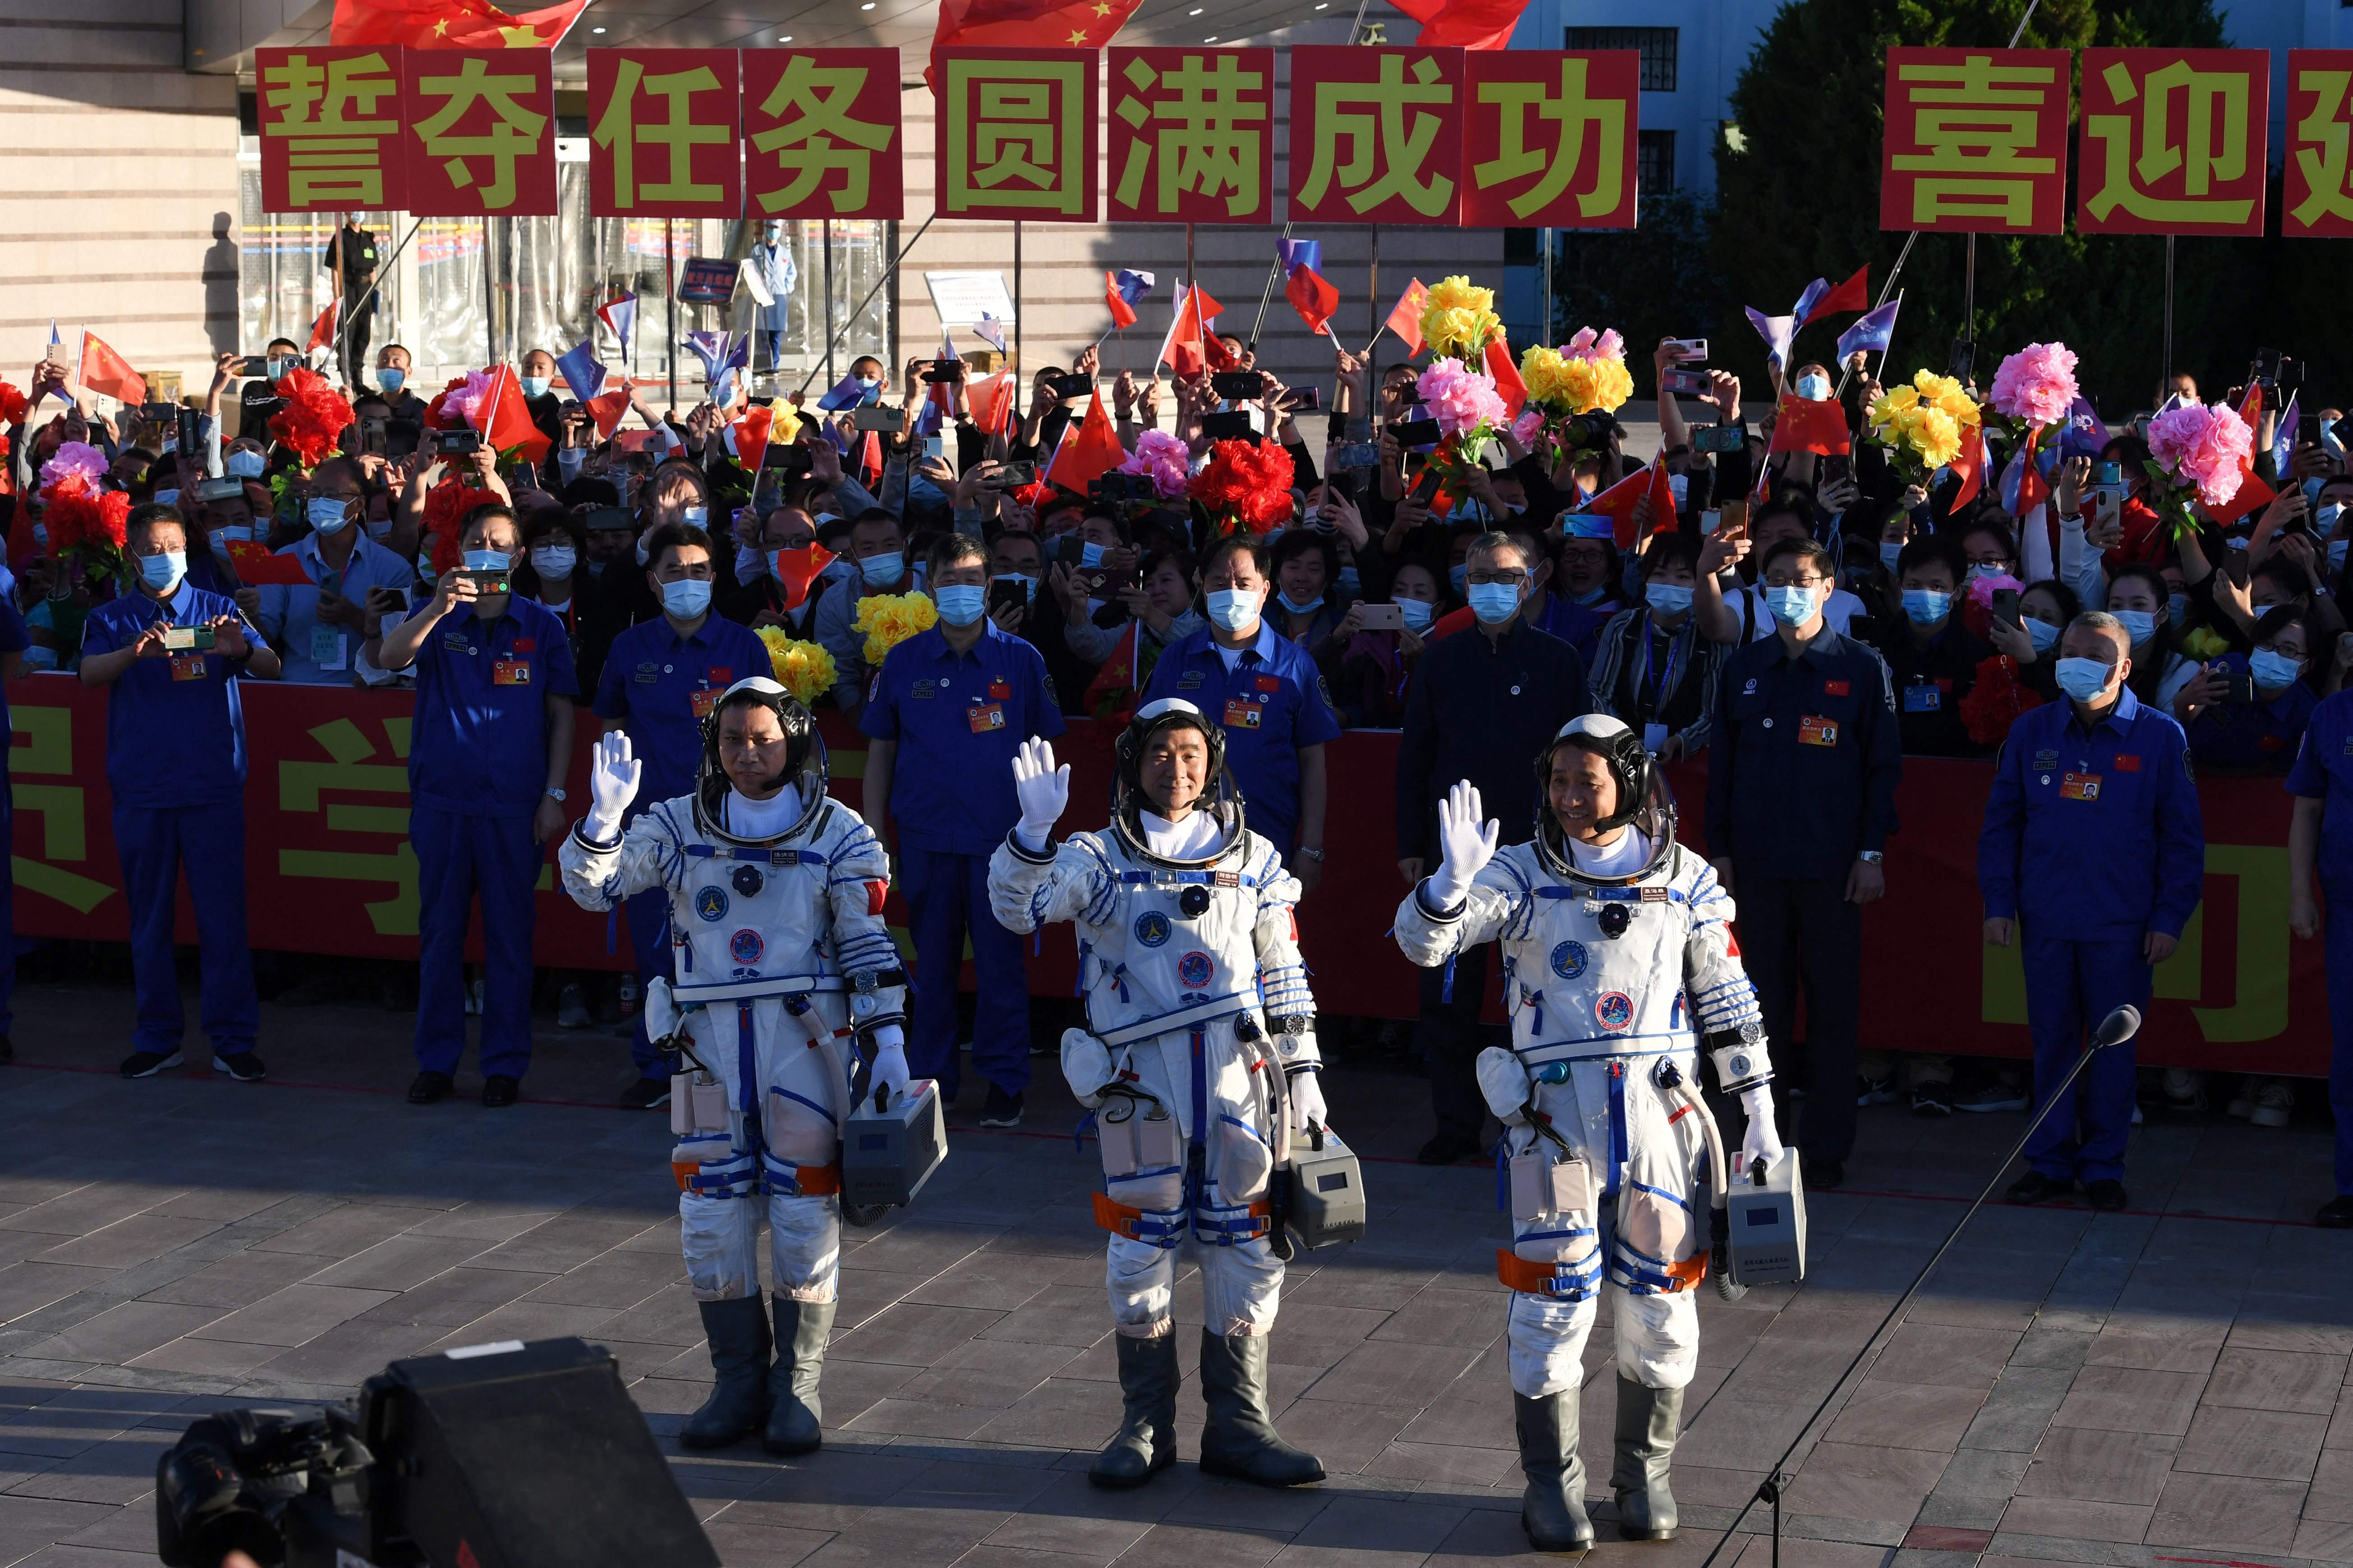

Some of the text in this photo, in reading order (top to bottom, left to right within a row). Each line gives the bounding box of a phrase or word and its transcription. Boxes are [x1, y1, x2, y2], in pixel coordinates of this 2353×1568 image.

[264, 52, 1626, 220] 誓夺任务圆满成功
